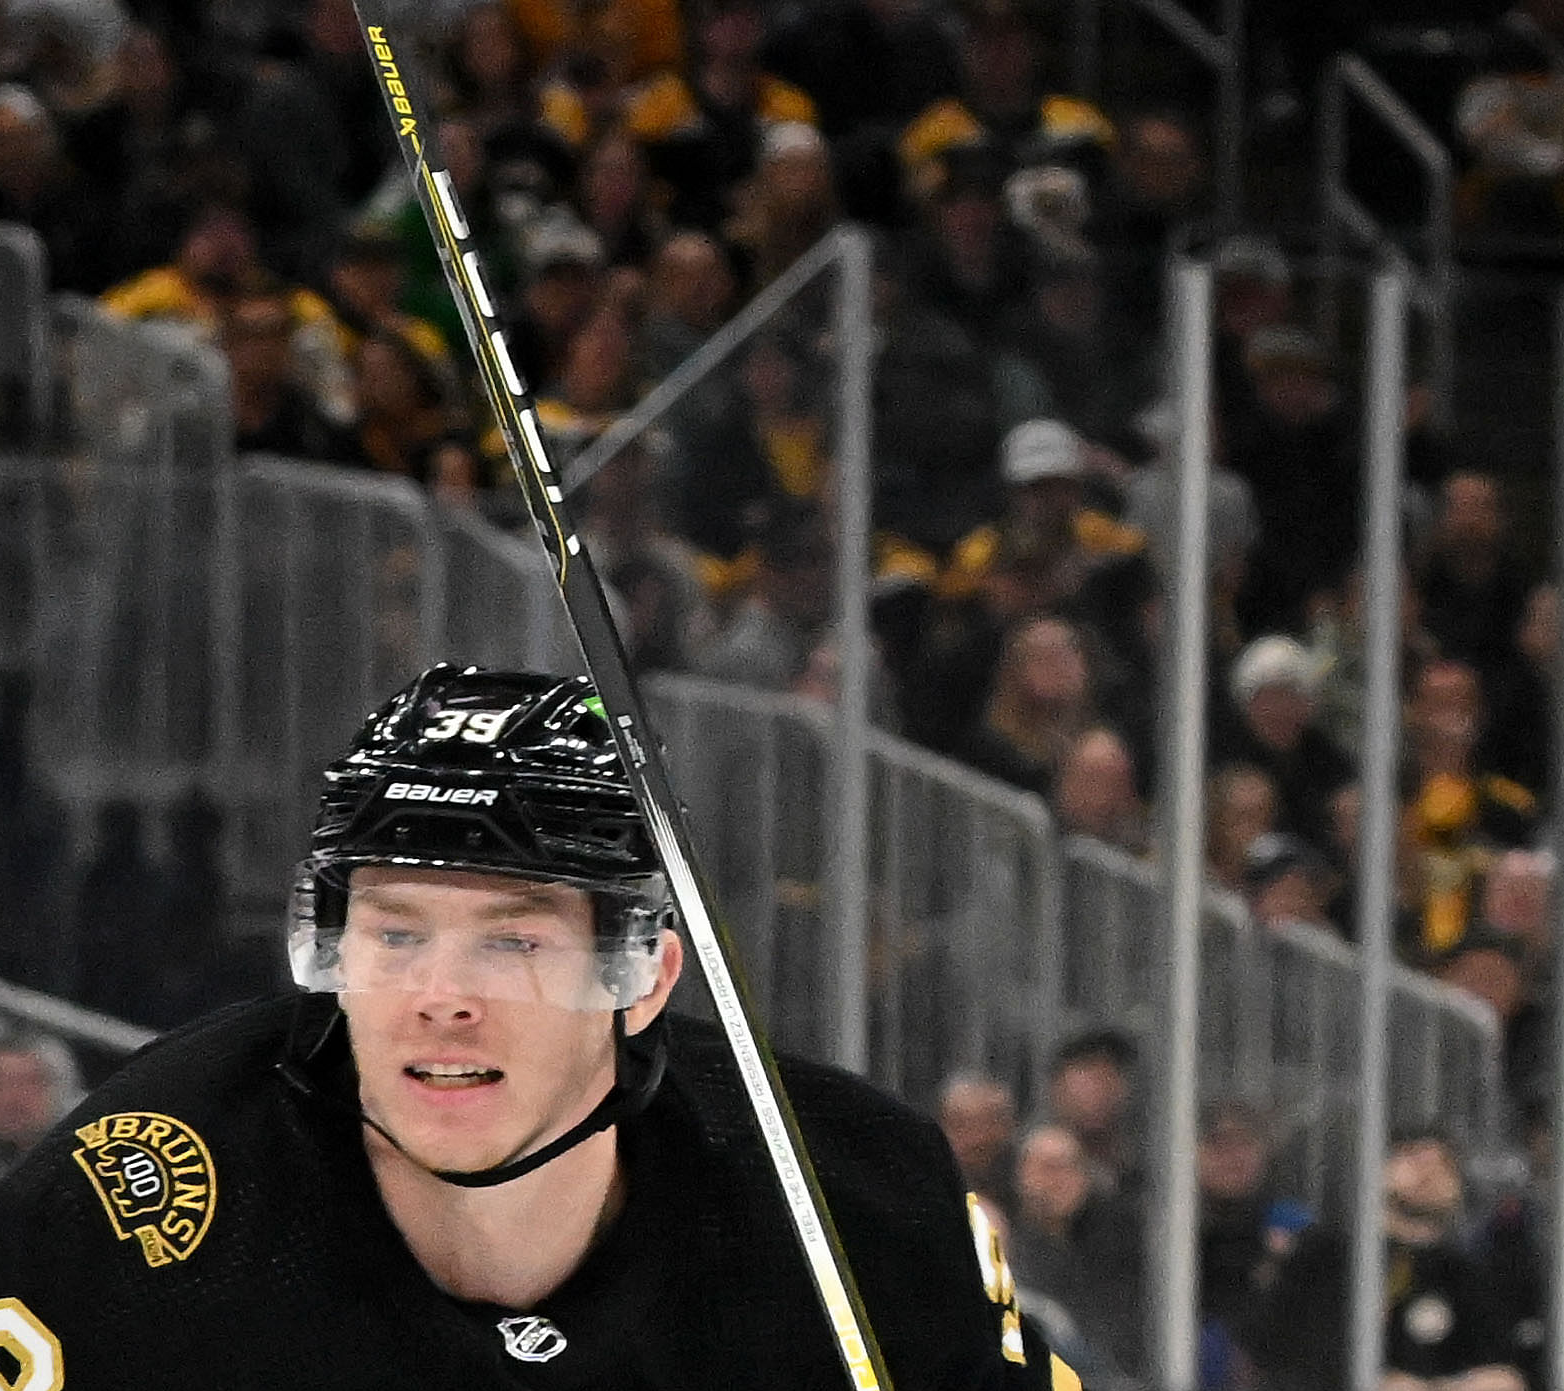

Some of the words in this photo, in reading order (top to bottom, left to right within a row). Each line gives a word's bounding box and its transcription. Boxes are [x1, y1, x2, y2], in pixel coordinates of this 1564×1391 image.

[368, 26, 412, 115] BAUER
[424, 710, 510, 744] 39
[384, 783, 499, 806] BAUER
[110, 1117, 207, 1243] BRUINS
[122, 1152, 161, 1198] 100
